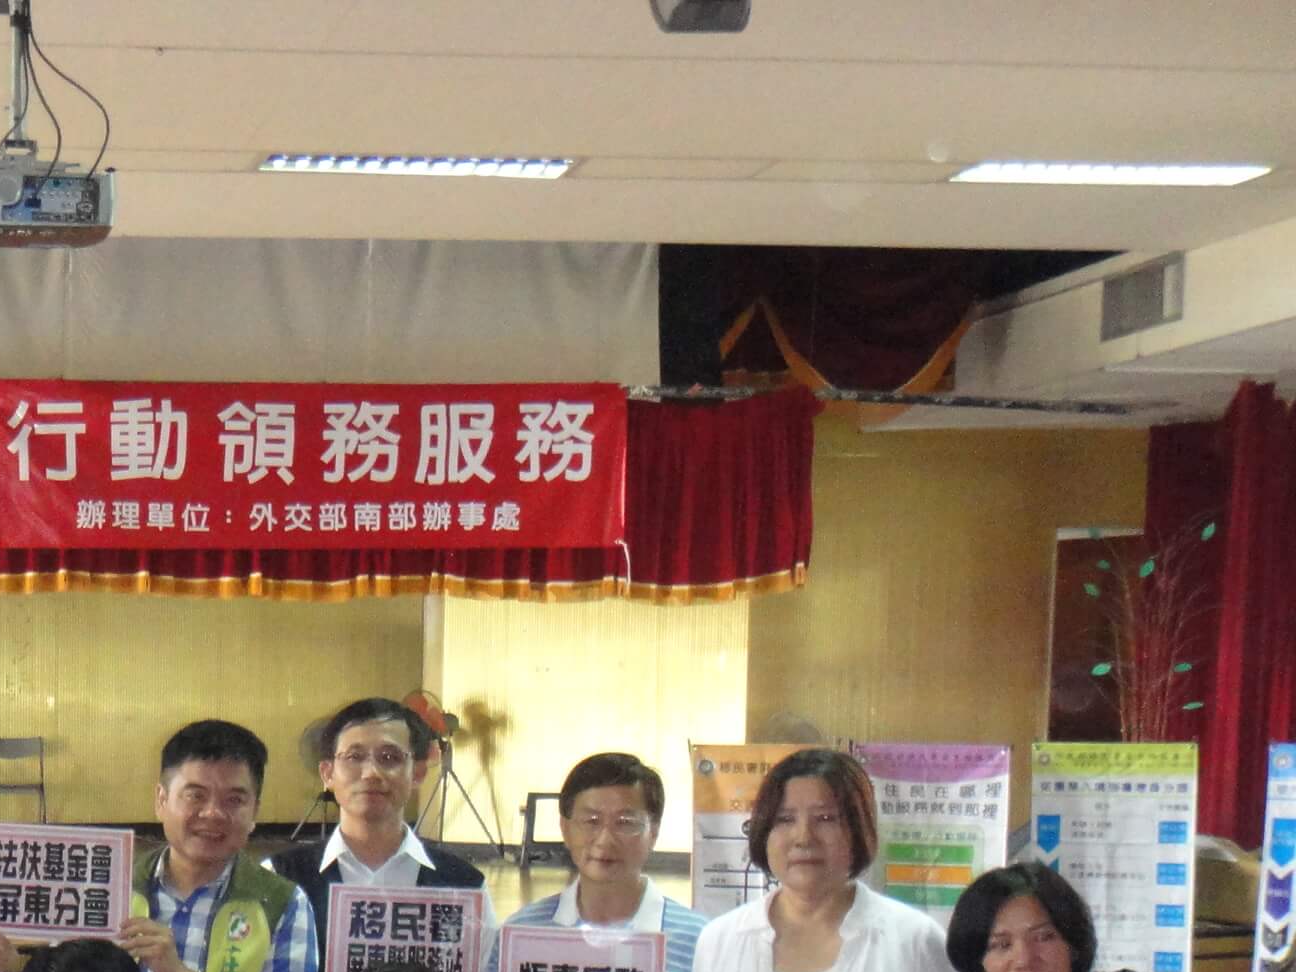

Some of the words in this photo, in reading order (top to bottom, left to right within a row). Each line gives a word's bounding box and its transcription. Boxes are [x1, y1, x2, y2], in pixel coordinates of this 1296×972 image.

[6, 397, 595, 486] 行動領務服務
[76, 500, 522, 534] 辦理單位：外交部南部辦事處
[349, 900, 464, 943] 移民署
